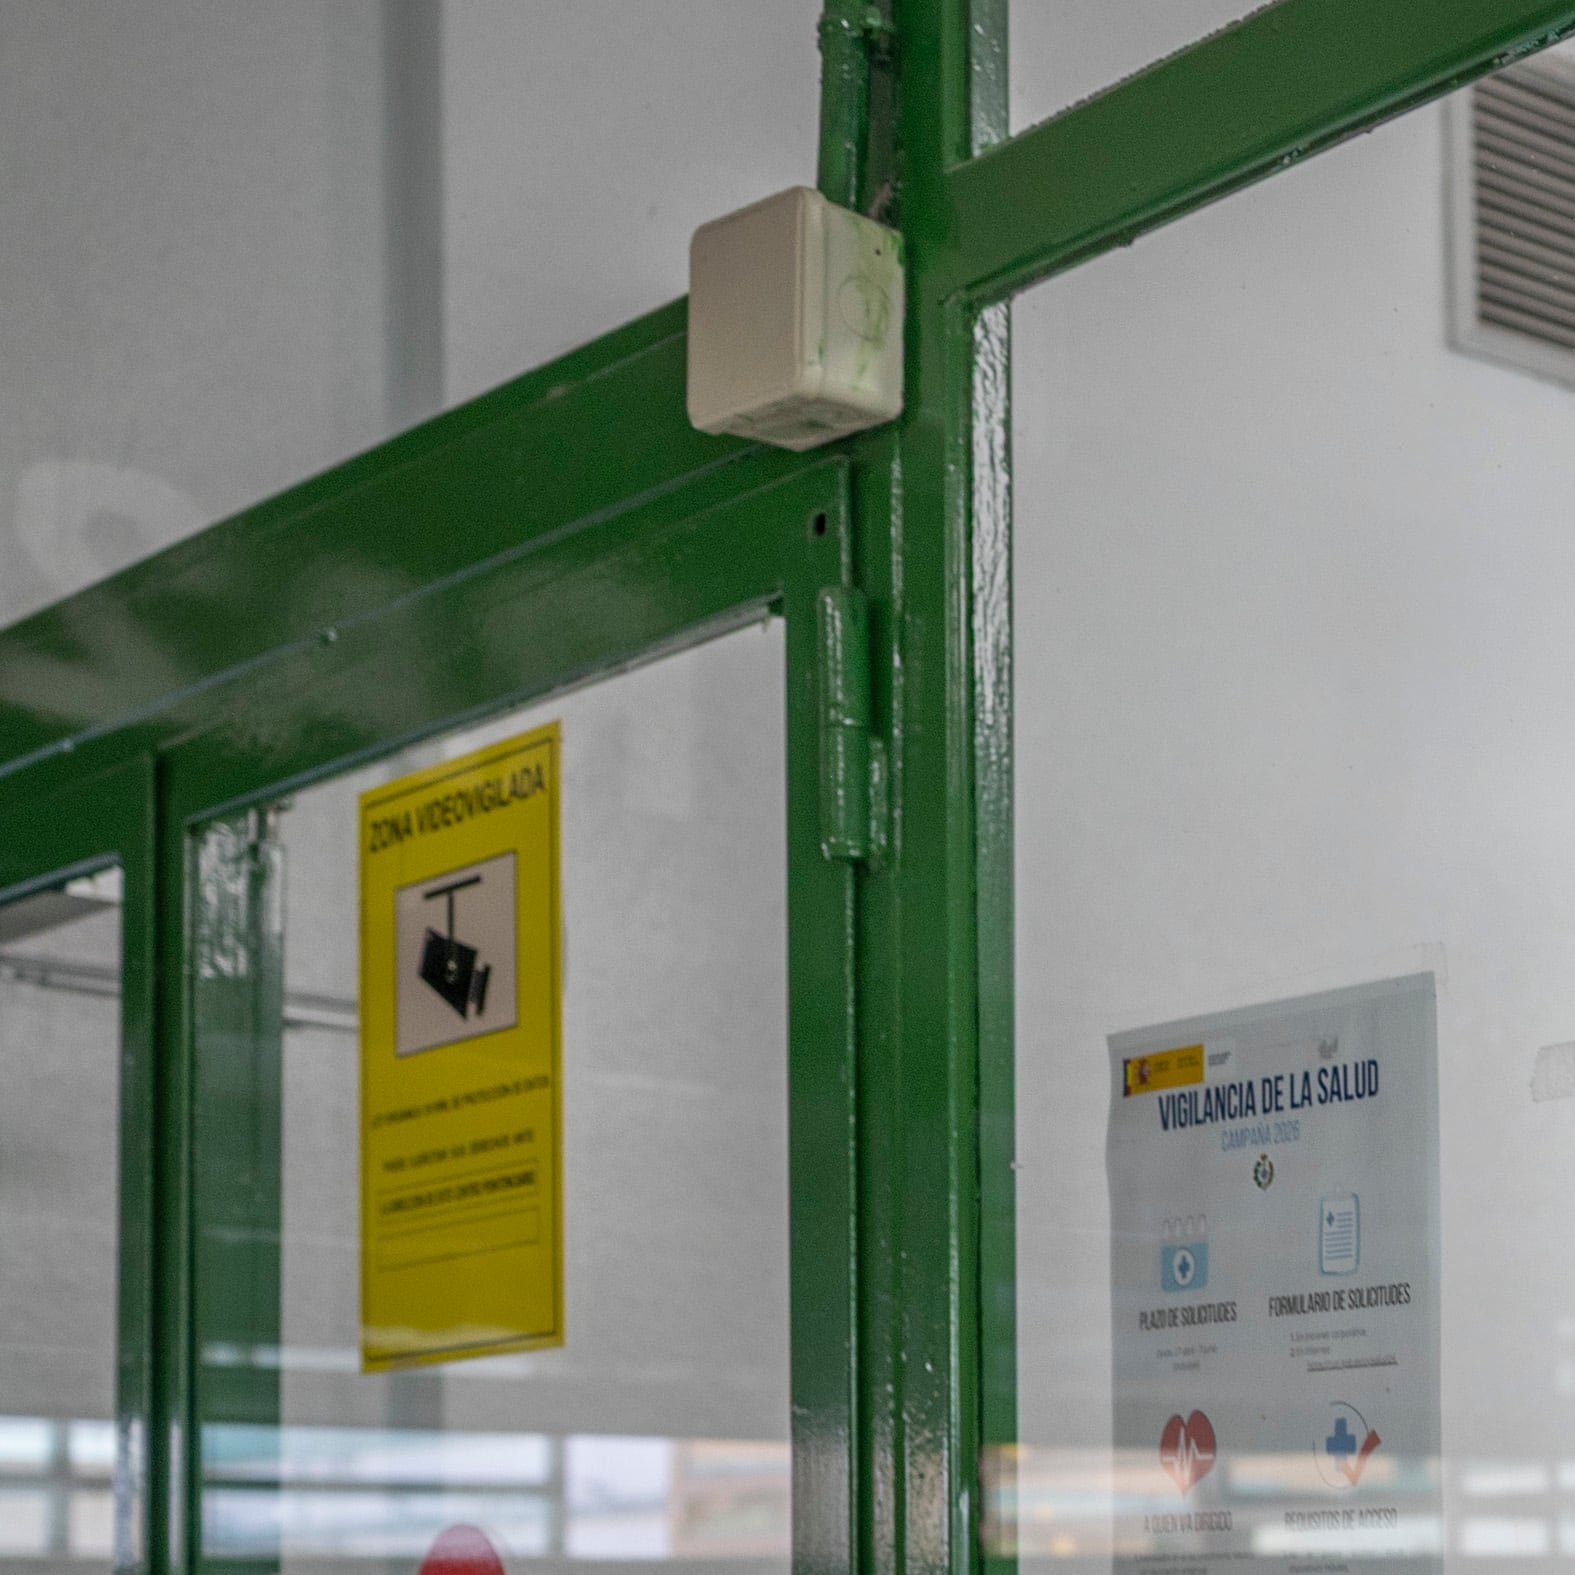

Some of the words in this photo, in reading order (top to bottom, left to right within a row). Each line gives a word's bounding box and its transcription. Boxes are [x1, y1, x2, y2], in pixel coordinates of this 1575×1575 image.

[369, 810, 412, 853] ZONA
[417, 764, 547, 836] VIDEOVIGILADA
[1158, 1080, 1257, 1131] VIGILANCIA
[1261, 1075, 1285, 1115] DE
[1290, 1071, 1313, 1109] LA
[1317, 1059, 1379, 1105] SALUD
[1268, 1290, 1331, 1317] FORMULARIO
[1332, 1289, 1346, 1312] DE
[1348, 1282, 1411, 1310] SOLICITUDES
